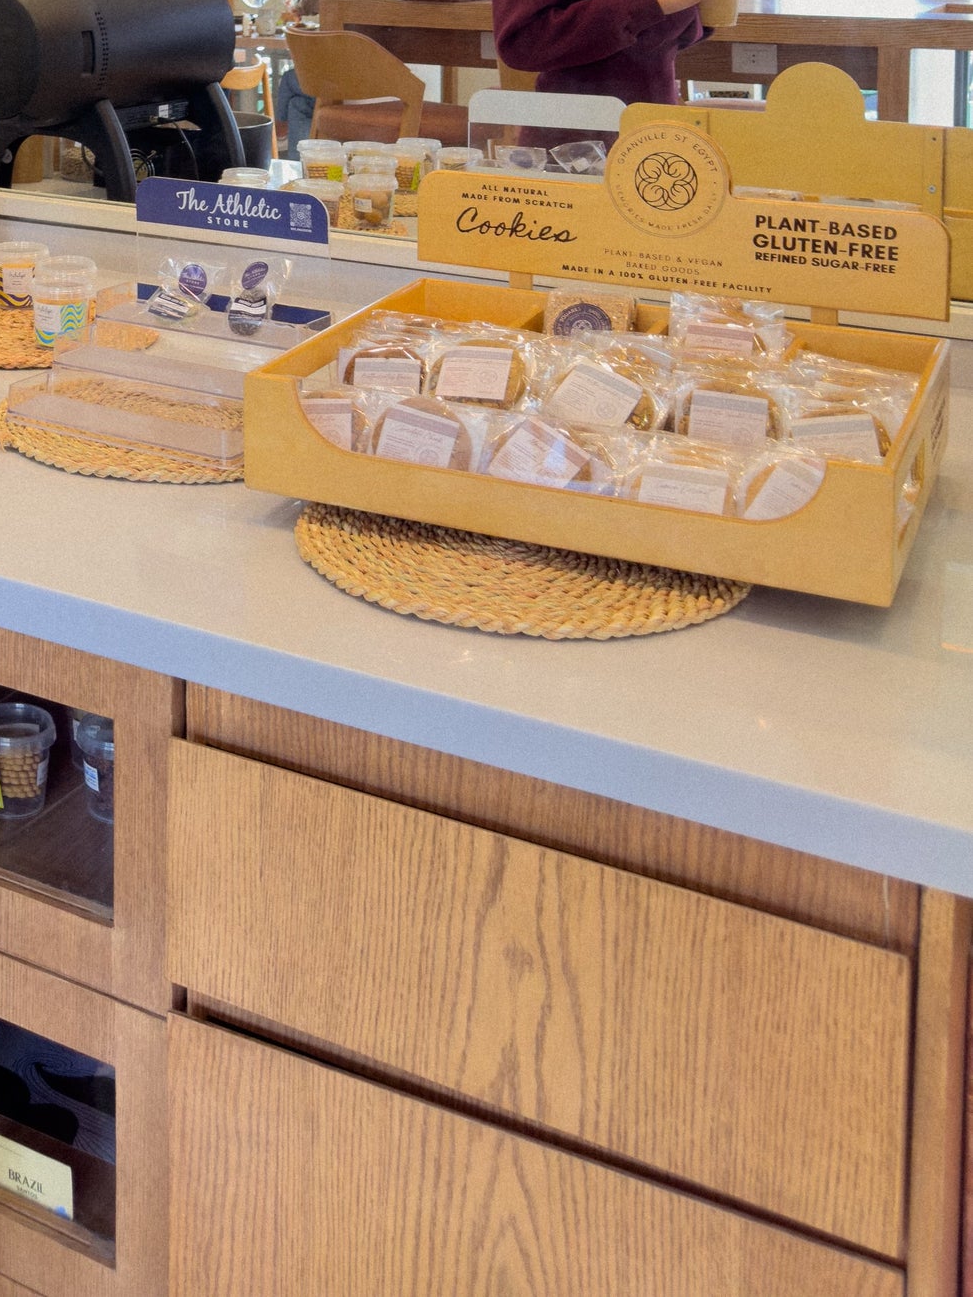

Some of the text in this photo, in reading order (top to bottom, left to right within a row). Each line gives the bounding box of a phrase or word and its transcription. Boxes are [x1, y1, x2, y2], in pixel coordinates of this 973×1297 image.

[617, 132, 718, 173] GRANVILLE ST EGYPT
[176, 187, 282, 220] The Athletic
[461, 192, 574, 209] MADE FROM SCRATCH
[481, 184, 549, 197] ALL NATURAL
[207, 216, 249, 229] STORE
[456, 206, 578, 243] Cookies
[755, 214, 898, 240] PLANT-BASED
[752, 233, 899, 262] GLUTEN-FREE
[626, 261, 700, 276] BAKED GOODS
[676, 256, 683, 264] &
[688, 258, 723, 268] VEGAN
[755, 252, 896, 274] REFINED SUGAR-FREE
[562, 264, 589, 273] MADE
[619, 271, 644, 280] 100%
[722, 282, 772, 294] FACILITY
[8, 1168, 43, 1194] BRAZIL
